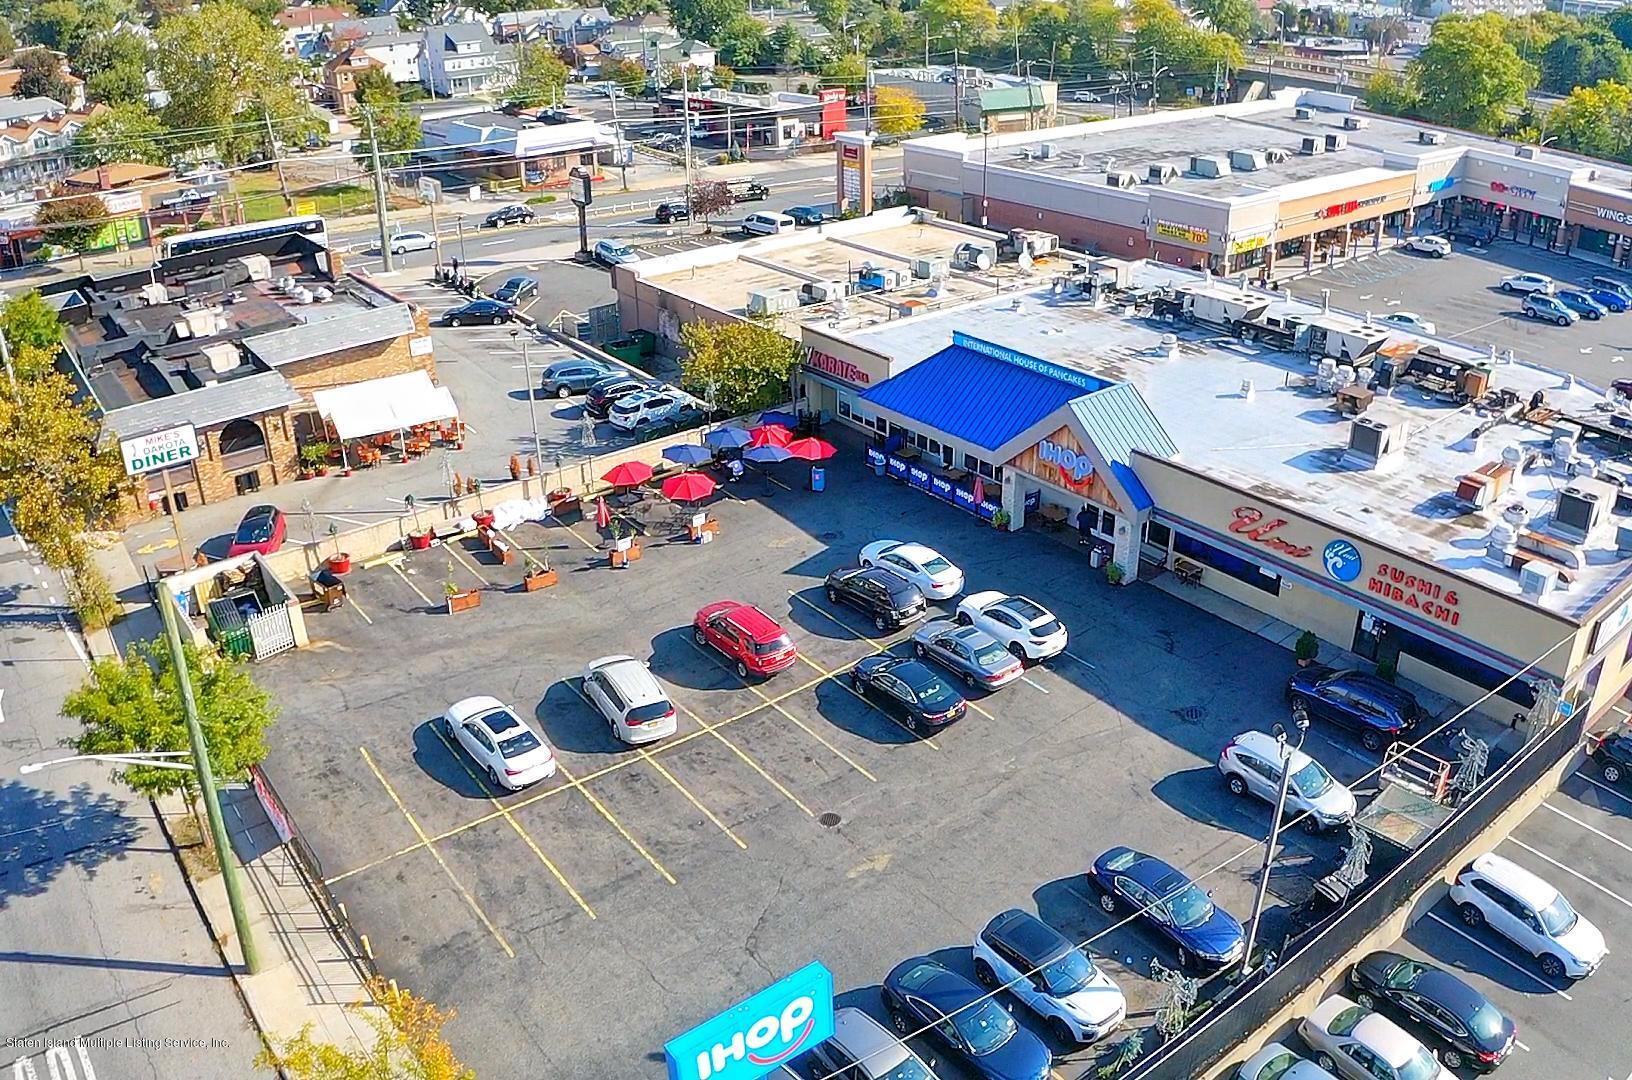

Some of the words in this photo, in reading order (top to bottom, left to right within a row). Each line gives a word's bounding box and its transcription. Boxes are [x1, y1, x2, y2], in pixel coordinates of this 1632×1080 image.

[812, 350, 858, 381] KARATE
[962, 339, 1012, 363] INTERNATIONAL
[1013, 355, 1038, 370] HOUSE
[1038, 364, 1048, 373] OF
[1049, 367, 1086, 388] PANCAKES
[131, 445, 192, 471] DINER
[143, 438, 187, 455] DAKOTA
[145, 430, 181, 446] MIKE'S
[1039, 439, 1094, 480] IHOP
[1228, 506, 1313, 558] Umi
[1368, 577, 1460, 626] HIBACHI
[1377, 563, 1442, 599] SUSHI
[1444, 590, 1459, 606] &
[696, 996, 814, 1080] IHOP
